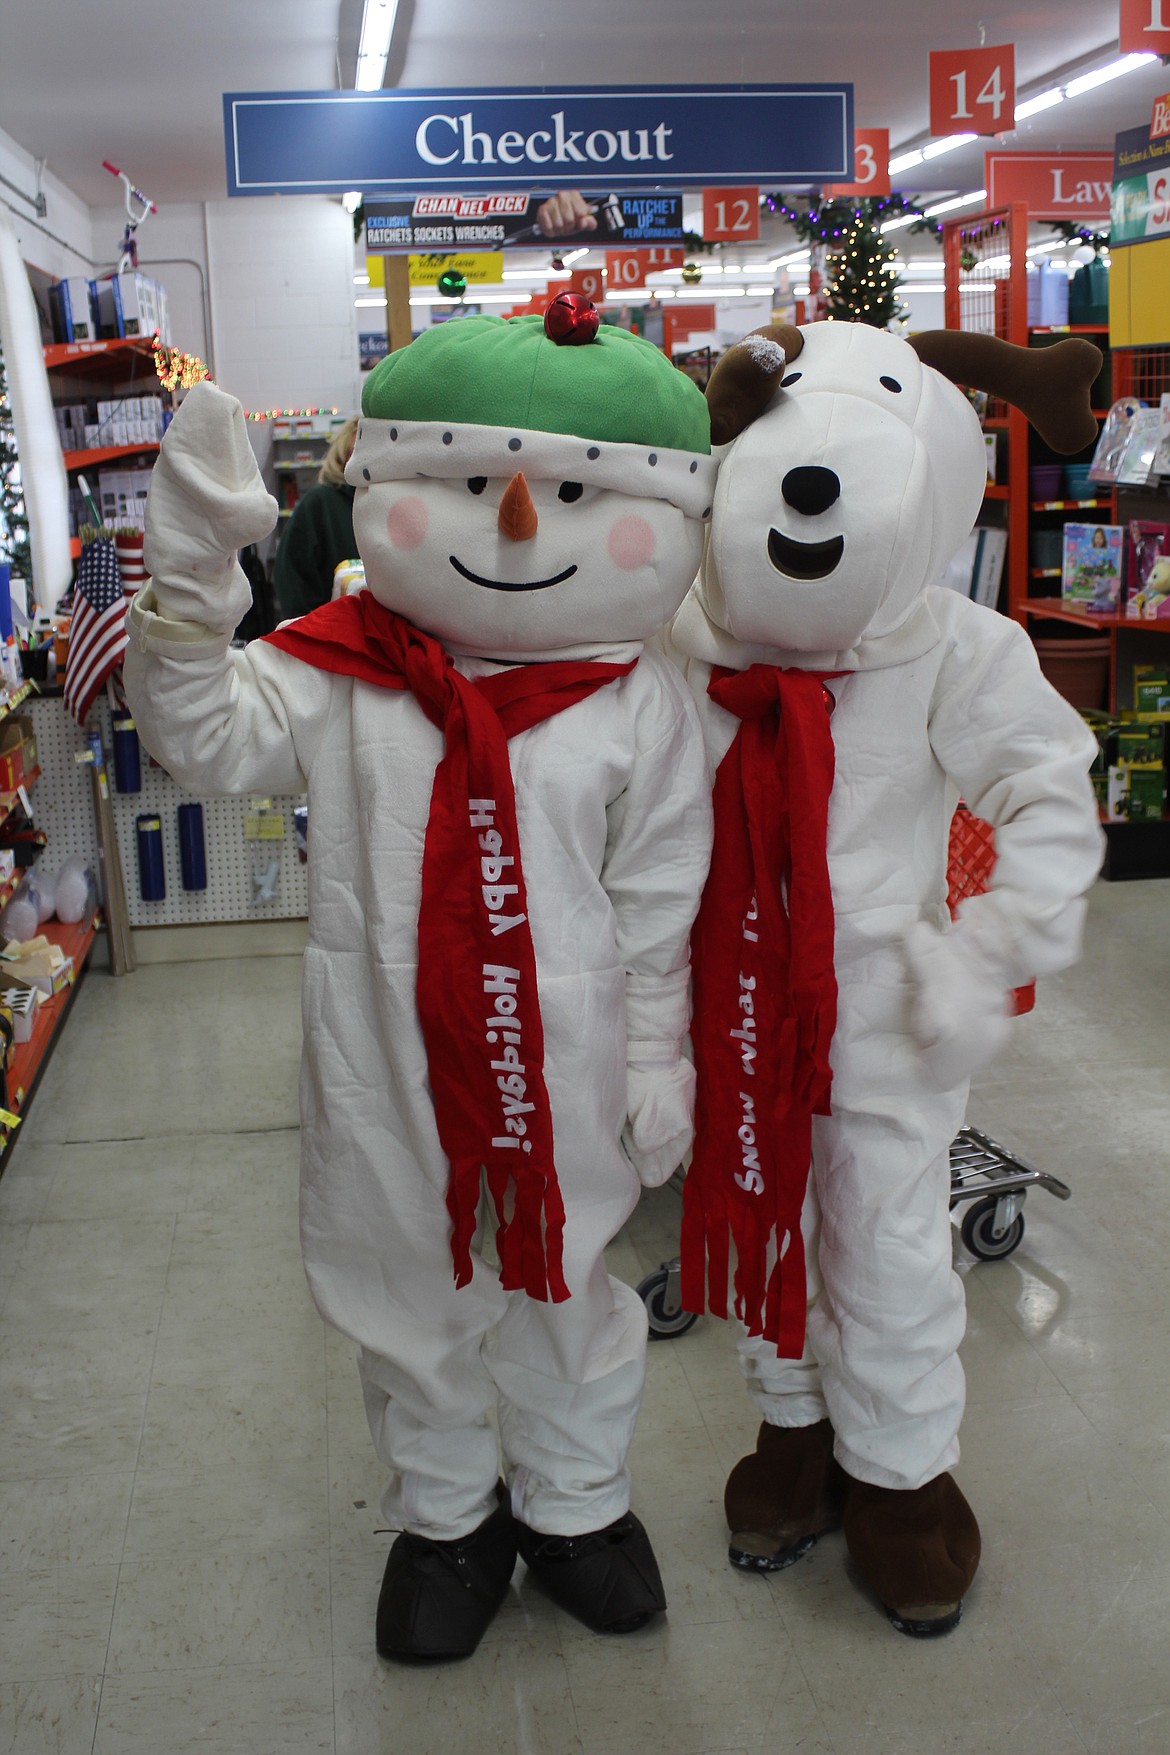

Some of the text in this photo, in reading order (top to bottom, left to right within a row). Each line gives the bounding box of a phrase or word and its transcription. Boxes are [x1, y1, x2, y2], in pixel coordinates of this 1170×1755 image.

[1142, 0, 1170, 31] 1
[949, 65, 1006, 121] 14
[415, 110, 675, 166] Checkout
[854, 143, 877, 184] 3
[623, 199, 677, 215] RATCHET
[1152, 177, 1170, 225] S
[367, 215, 410, 228] EXCLUSIVE
[637, 214, 654, 229] UP
[713, 200, 751, 233] 12
[368, 225, 505, 243] RATCHETS SOCKETS WRENCHES
[623, 227, 682, 239] PERFORMANCE
[612, 258, 640, 283] 10
[582, 275, 597, 299] 9
[729, 970, 757, 1075] what
